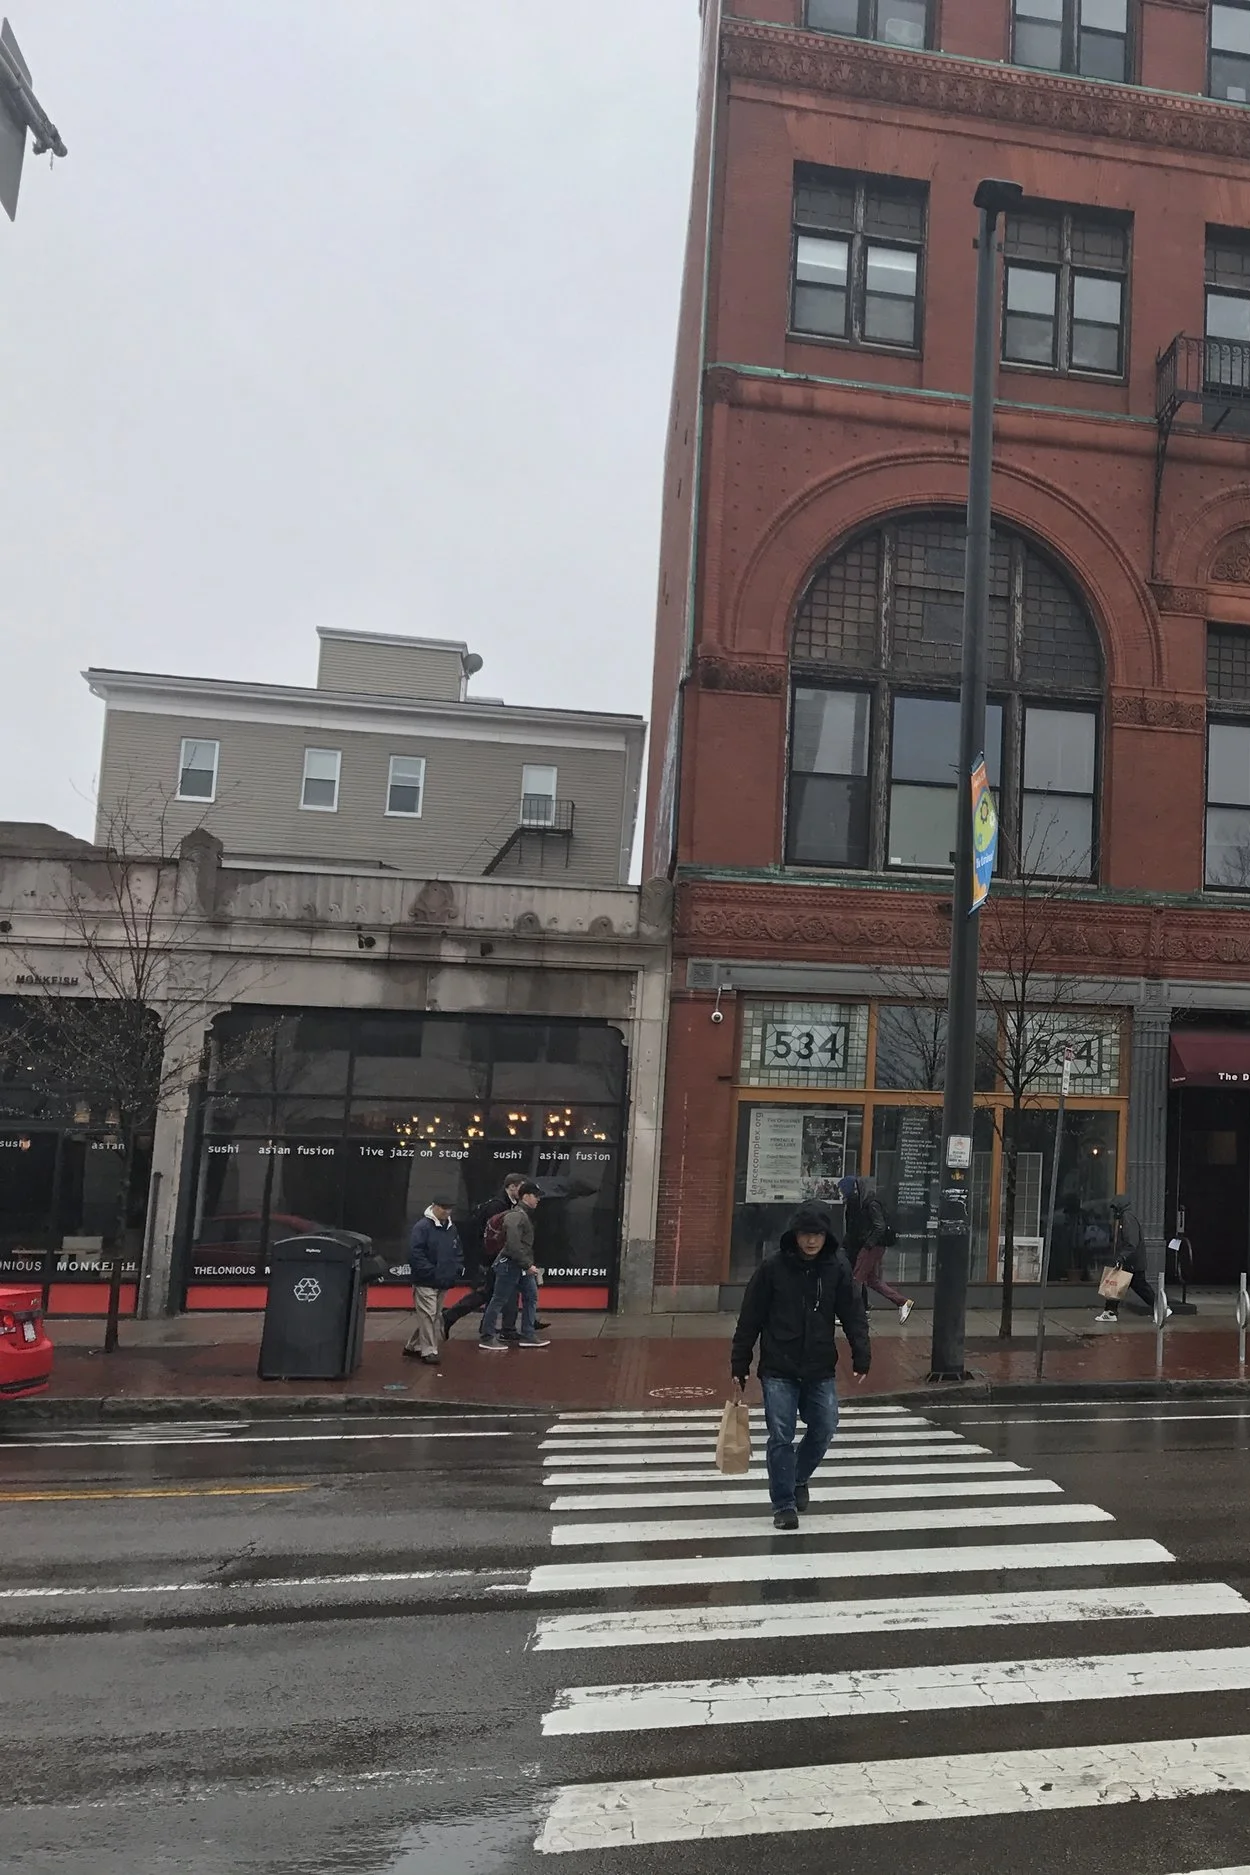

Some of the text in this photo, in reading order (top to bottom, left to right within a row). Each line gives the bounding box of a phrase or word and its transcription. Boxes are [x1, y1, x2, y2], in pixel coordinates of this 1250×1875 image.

[773, 1031, 839, 1061] 534
[1218, 1073, 1238, 1081] The
[208, 1144, 611, 1161] sushi asian fusion live jazz on stage sushi asian fusion
[0, 1261, 42, 1271] NIOUS
[194, 1266, 256, 1275] THELONIOUS
[548, 1268, 607, 1276] MONKFISH
